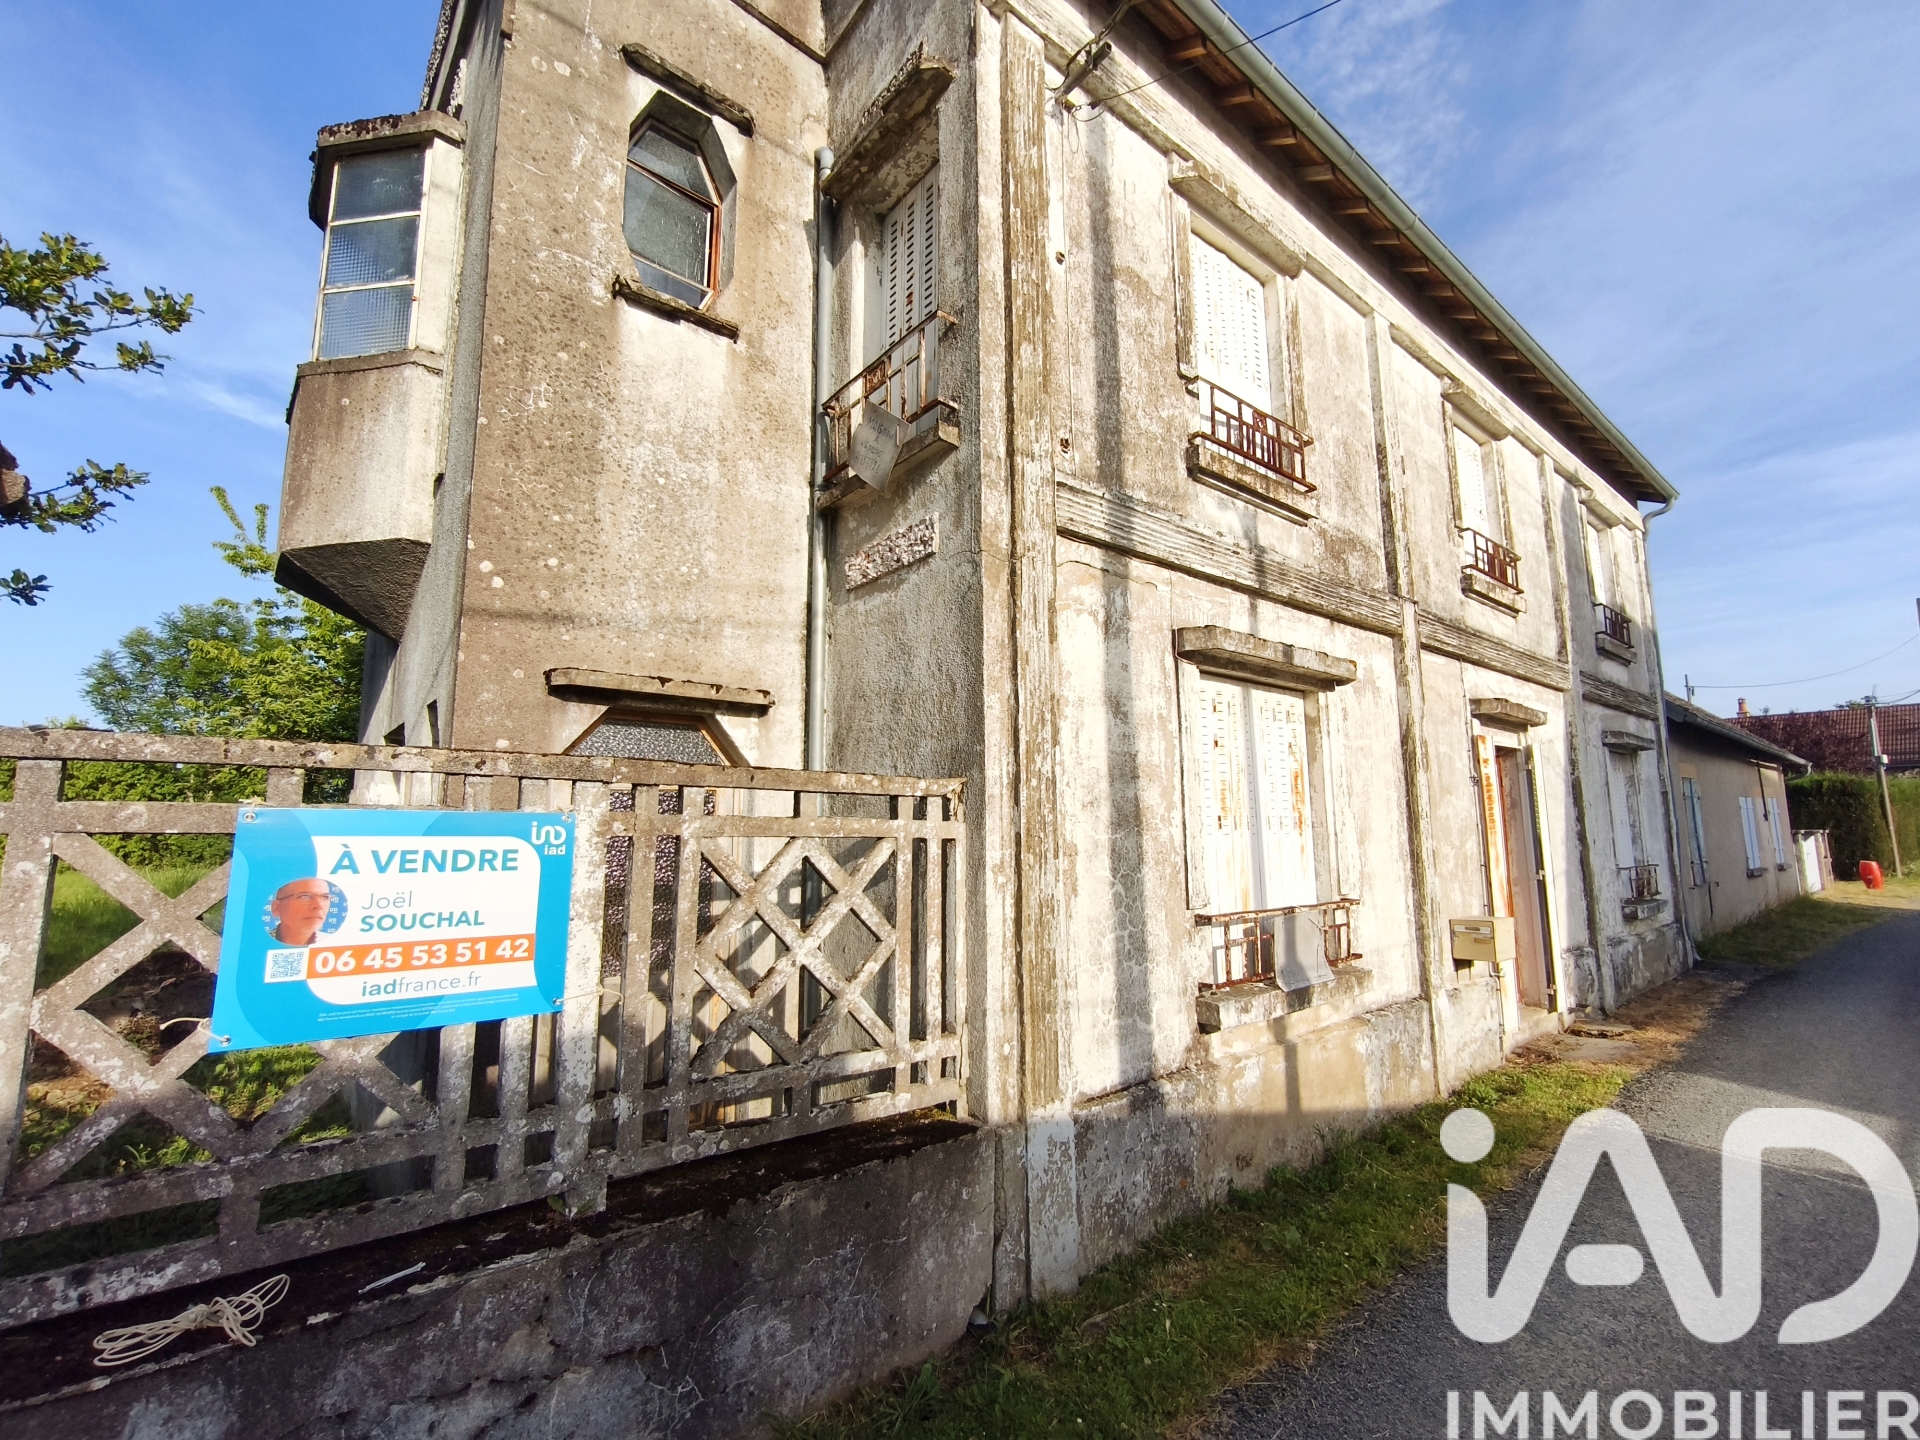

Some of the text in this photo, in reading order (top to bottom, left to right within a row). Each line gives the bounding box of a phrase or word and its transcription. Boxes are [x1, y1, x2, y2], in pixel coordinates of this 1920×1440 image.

[330, 843, 519, 875] À VENDRE
[544, 844, 566, 855] iad
[361, 890, 412, 910] Joël
[359, 909, 485, 932] SOUCHAL
[314, 937, 529, 973] 06 45 53 51 42
[361, 970, 481, 997] iadfrance.fr
